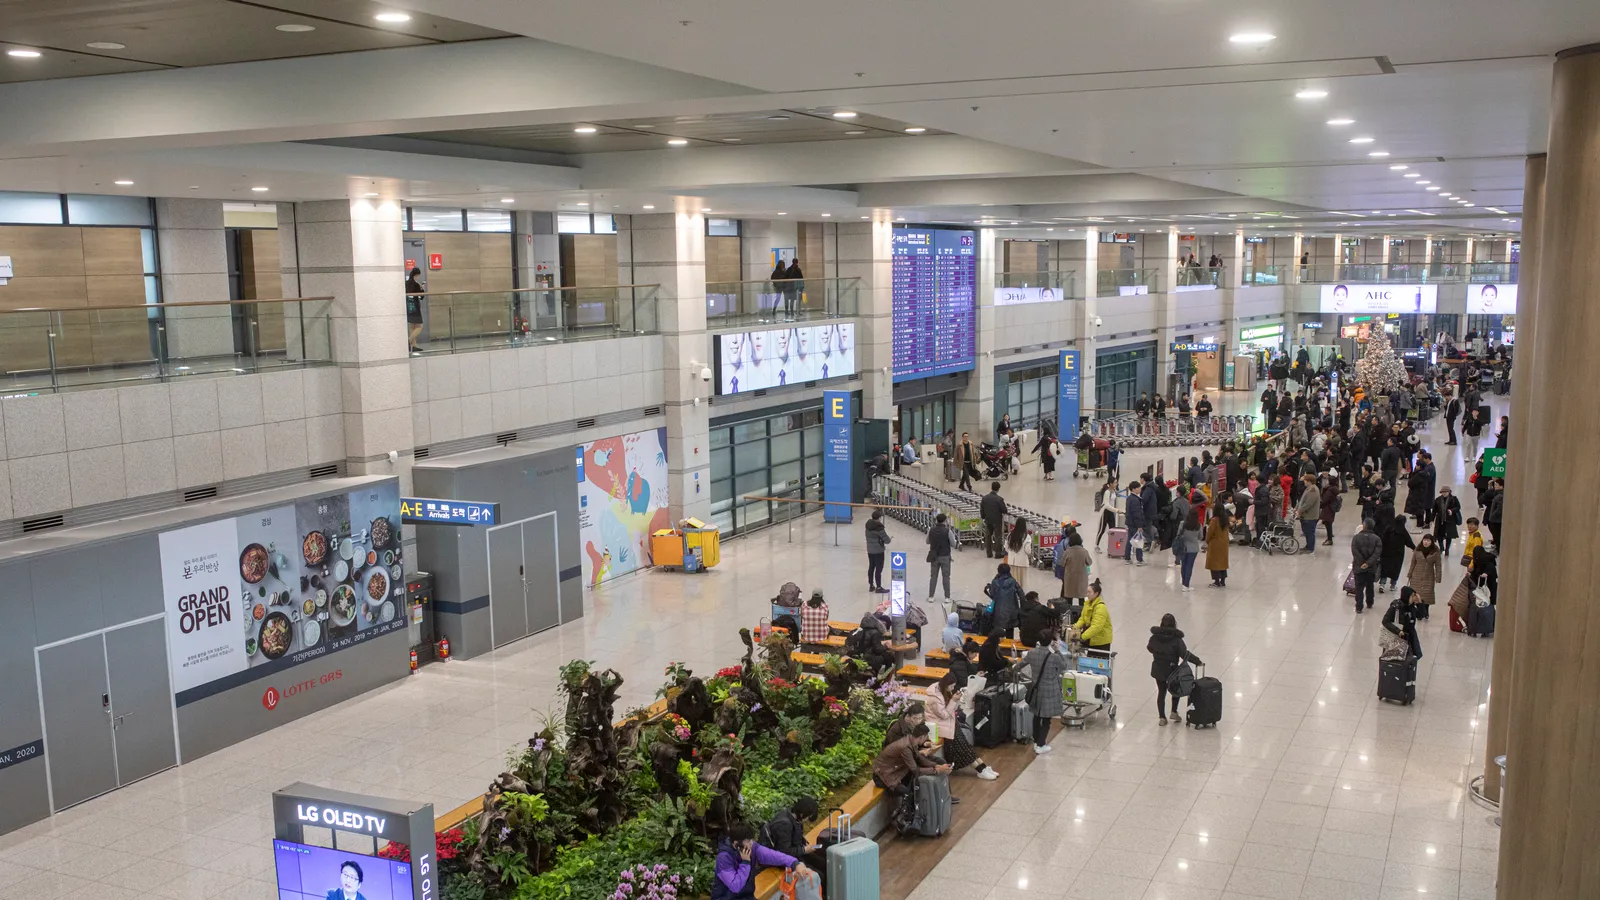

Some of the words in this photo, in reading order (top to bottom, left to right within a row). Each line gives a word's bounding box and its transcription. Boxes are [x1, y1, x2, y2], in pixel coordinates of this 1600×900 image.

[1365, 291, 1392, 300] AHC
[1174, 343, 1187, 351] A-D
[1065, 355, 1074, 369] E
[832, 398, 844, 418] E
[400, 501, 423, 517] A-E
[428, 511, 450, 519] Arrivals
[452, 508, 465, 517] 도착
[261, 517, 272, 527] 경상
[1044, 536, 1058, 544] BYC
[178, 585, 229, 612] GRAND
[180, 601, 231, 634] OPEN
[354, 632, 366, 641] 2019
[392, 619, 404, 629] 2020
[283, 679, 316, 698] LOTTE
[319, 669, 343, 685] GRS
[16, 745, 36, 759] 2020
[297, 804, 319, 822] LG
[322, 808, 364, 829] OLED
[364, 815, 386, 834] TV
[420, 853, 430, 876] LG
[422, 878, 431, 900] OL
